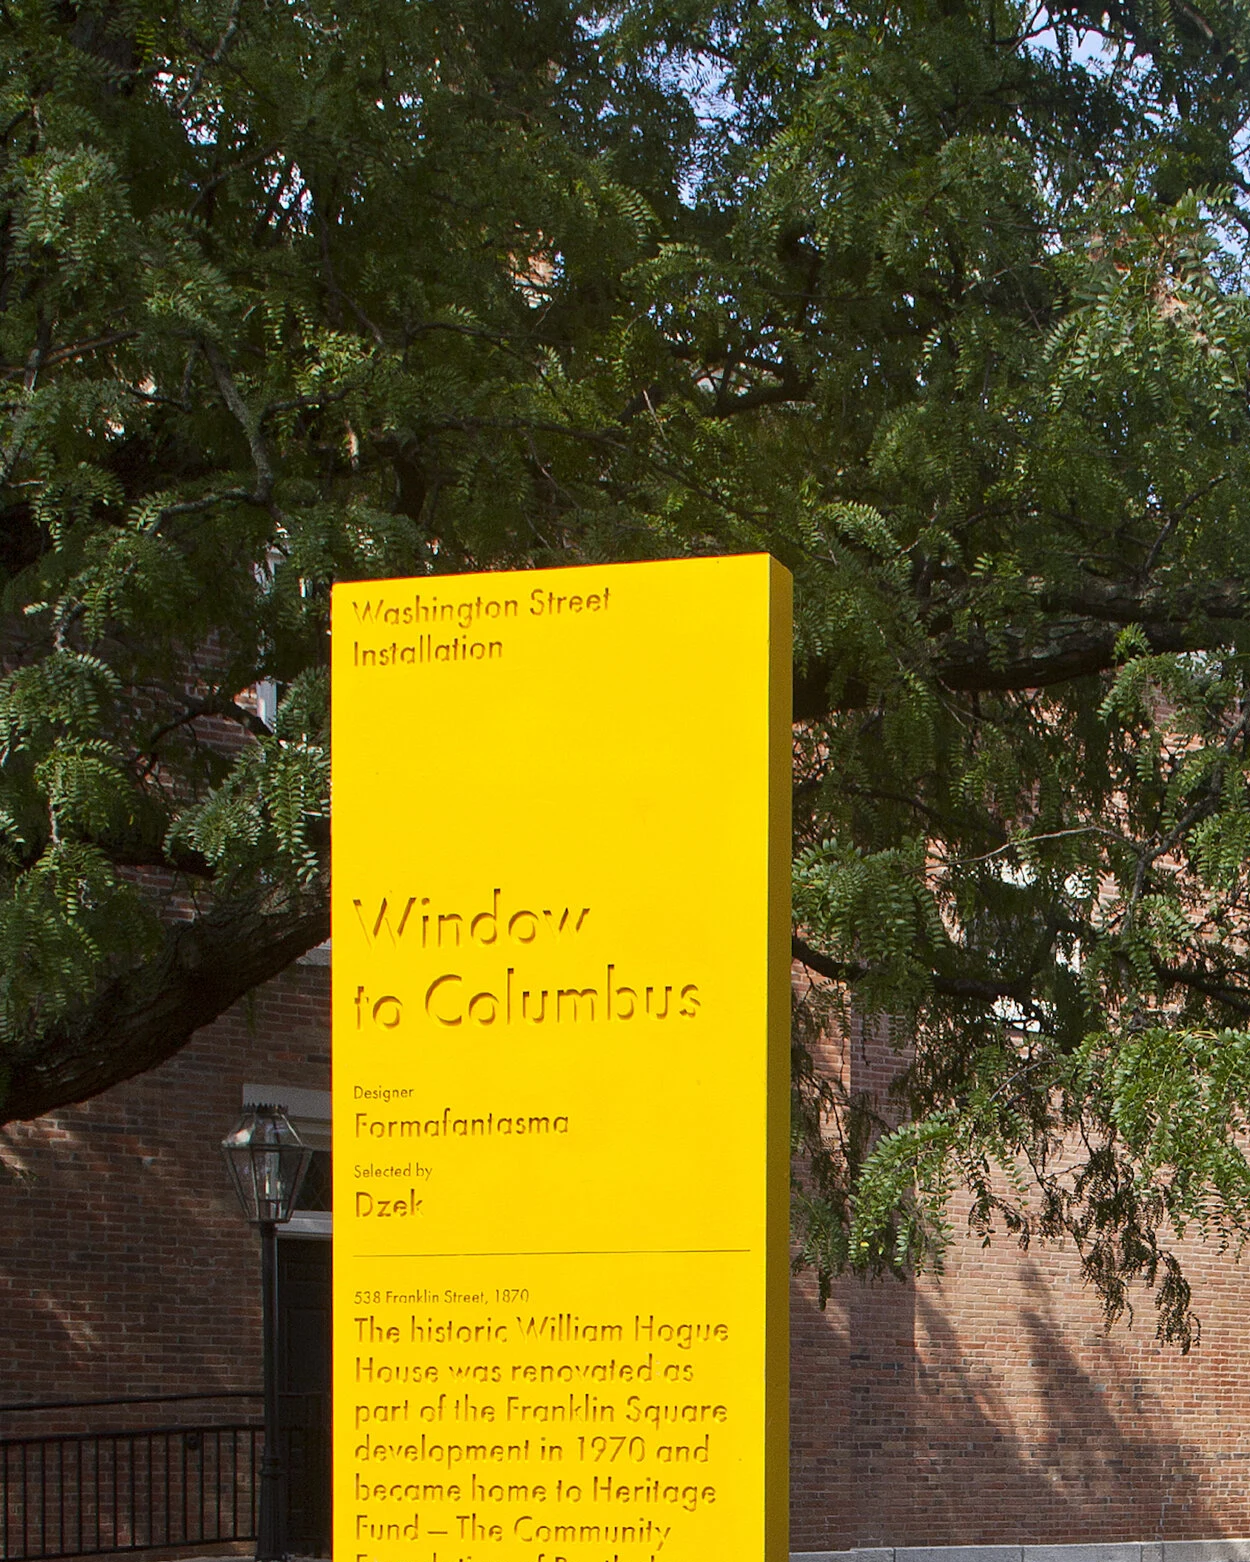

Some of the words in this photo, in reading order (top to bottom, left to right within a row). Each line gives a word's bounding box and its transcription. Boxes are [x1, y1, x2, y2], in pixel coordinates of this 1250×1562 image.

[352, 594, 519, 630] Washington
[529, 586, 612, 617] Street
[352, 634, 504, 667] Installation
[352, 887, 591, 951] Window
[354, 985, 403, 1031] to
[423, 964, 702, 1029] Columbus
[353, 1085, 414, 1103] Designer
[354, 1107, 569, 1139] Formafantasma
[353, 1163, 412, 1179] Selected
[415, 1162, 433, 1181] by
[354, 1188, 424, 1218] Dzek
[354, 1290, 381, 1305] 538
[385, 1289, 440, 1304] Franklin
[443, 1289, 489, 1305] Street,
[494, 1289, 530, 1304] 1870
[354, 1316, 401, 1344] The
[411, 1316, 508, 1343] historic
[516, 1313, 623, 1343] William
[634, 1315, 730, 1350] Hogue
[354, 1357, 440, 1383] House
[449, 1364, 503, 1382] was
[511, 1353, 654, 1383] renovated
[663, 1361, 695, 1382] as
[354, 1398, 410, 1430] part
[419, 1394, 446, 1422] of
[454, 1395, 496, 1422] the
[506, 1393, 615, 1422] Franklin
[625, 1395, 728, 1431] Square
[354, 1434, 530, 1470] development
[540, 1437, 563, 1462] in
[577, 1436, 646, 1463] 1970
[656, 1434, 710, 1464] and
[354, 1473, 461, 1503] became
[471, 1474, 547, 1503] home
[557, 1479, 582, 1503] to
[593, 1476, 717, 1512] Heritage
[355, 1514, 419, 1542] Fund
[456, 1513, 503, 1542] The
[513, 1516, 671, 1551] Community
